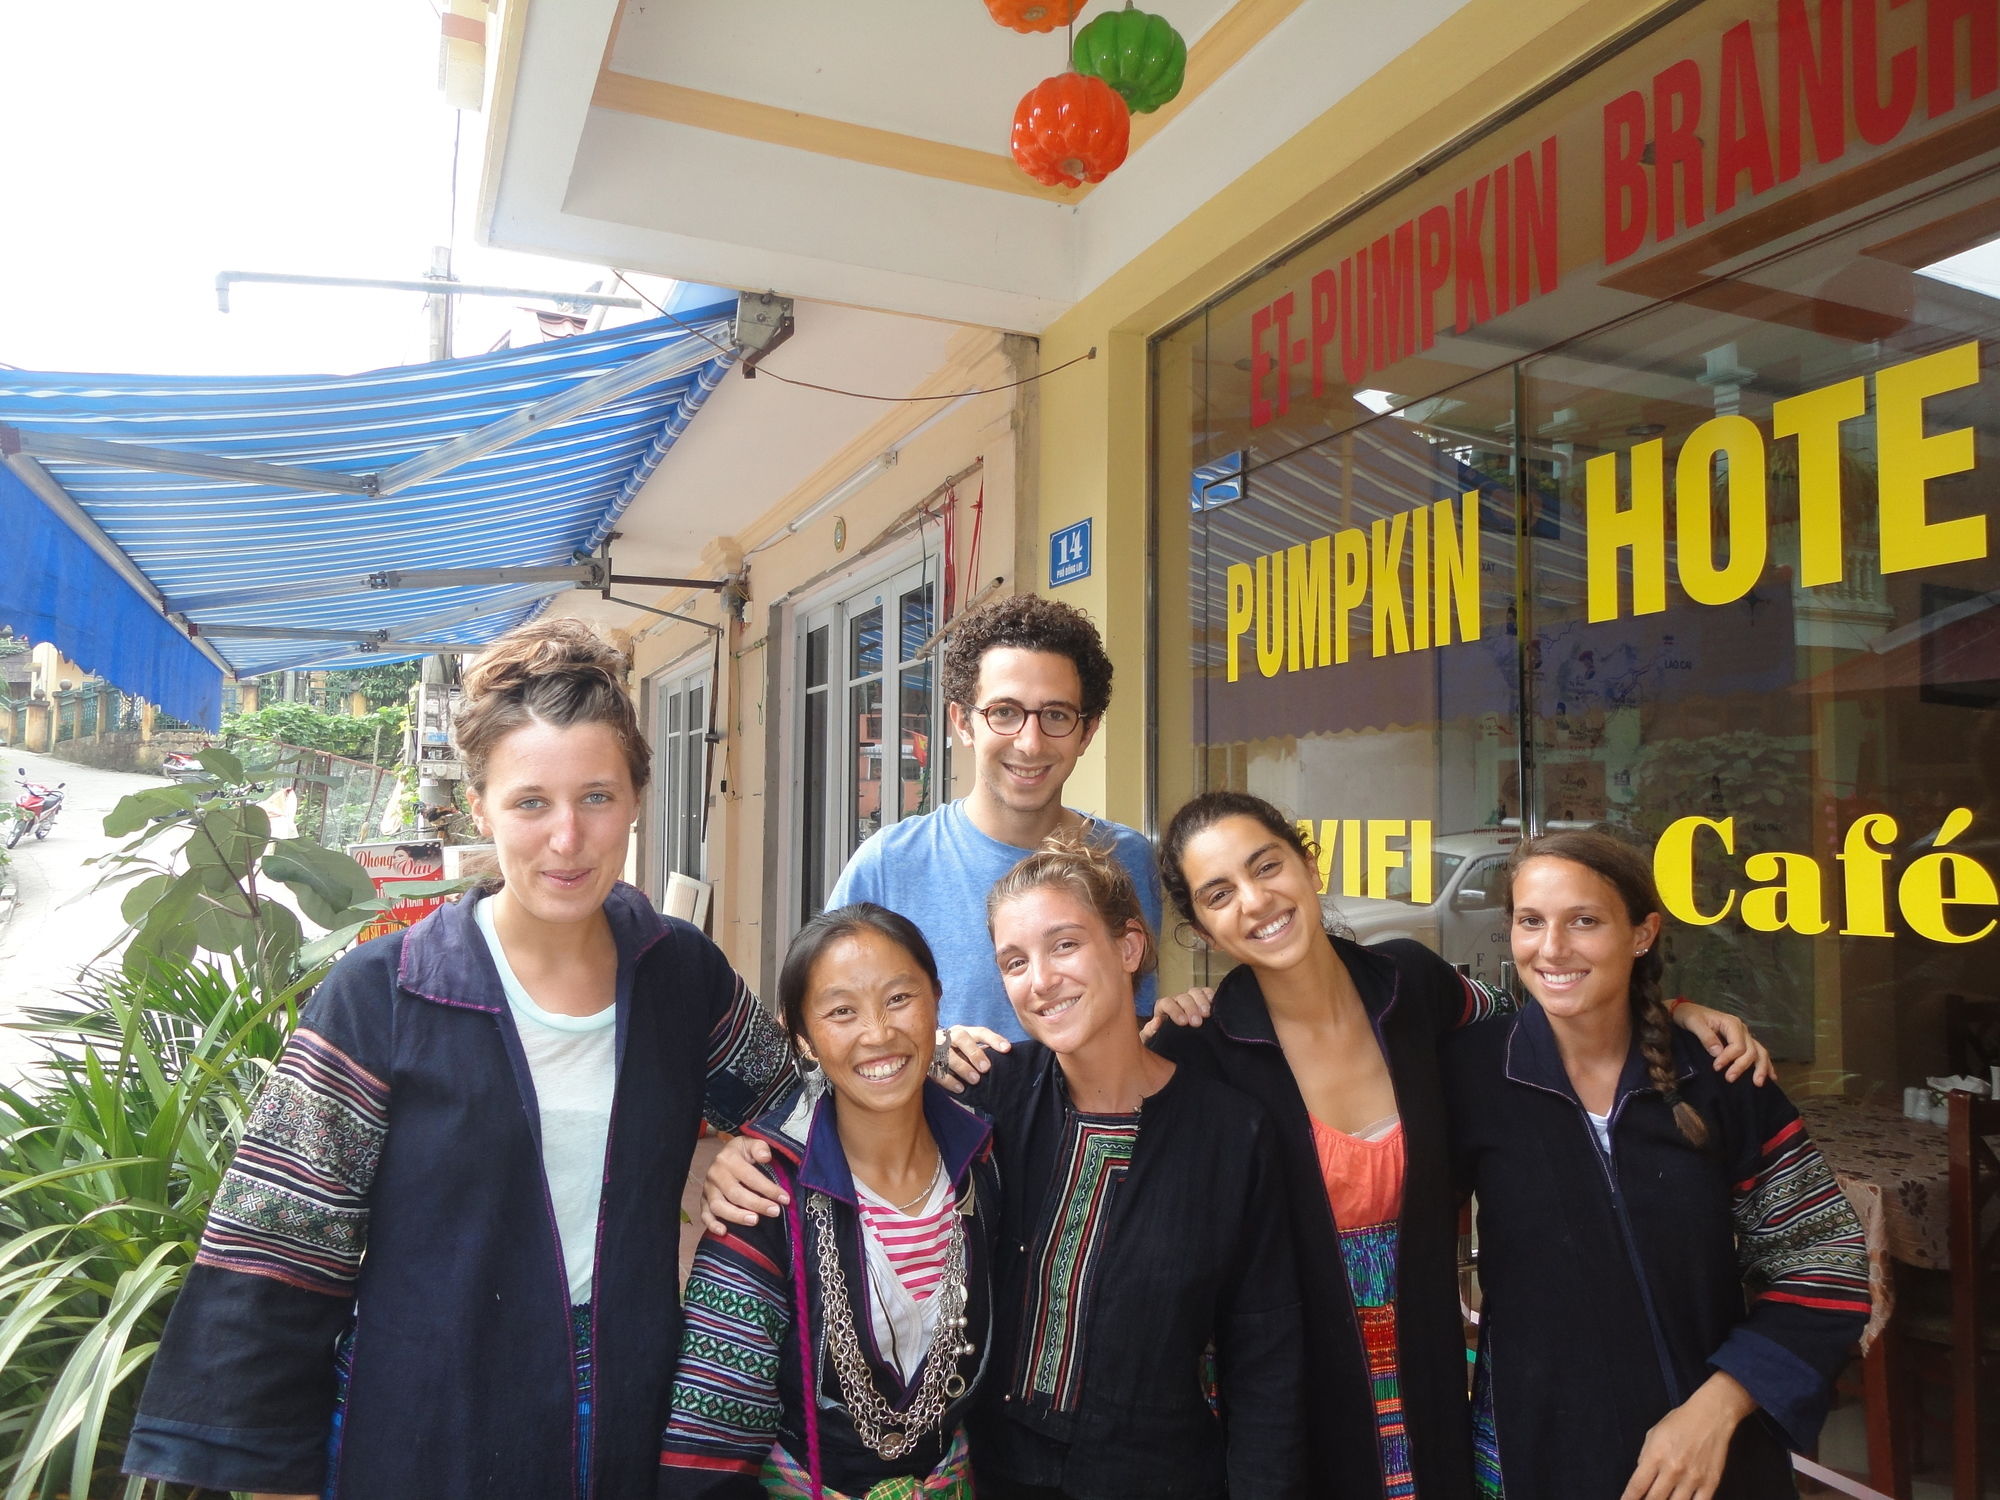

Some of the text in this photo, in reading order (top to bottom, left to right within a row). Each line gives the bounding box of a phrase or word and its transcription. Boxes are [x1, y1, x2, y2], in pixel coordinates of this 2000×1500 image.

[1250, 0, 2000, 428] ET-PUMPKIN BRANCH
[1058, 529, 1083, 566] 14
[1227, 341, 1988, 683] PUMPKIN HOTE
[1653, 807, 1999, 944] Café
